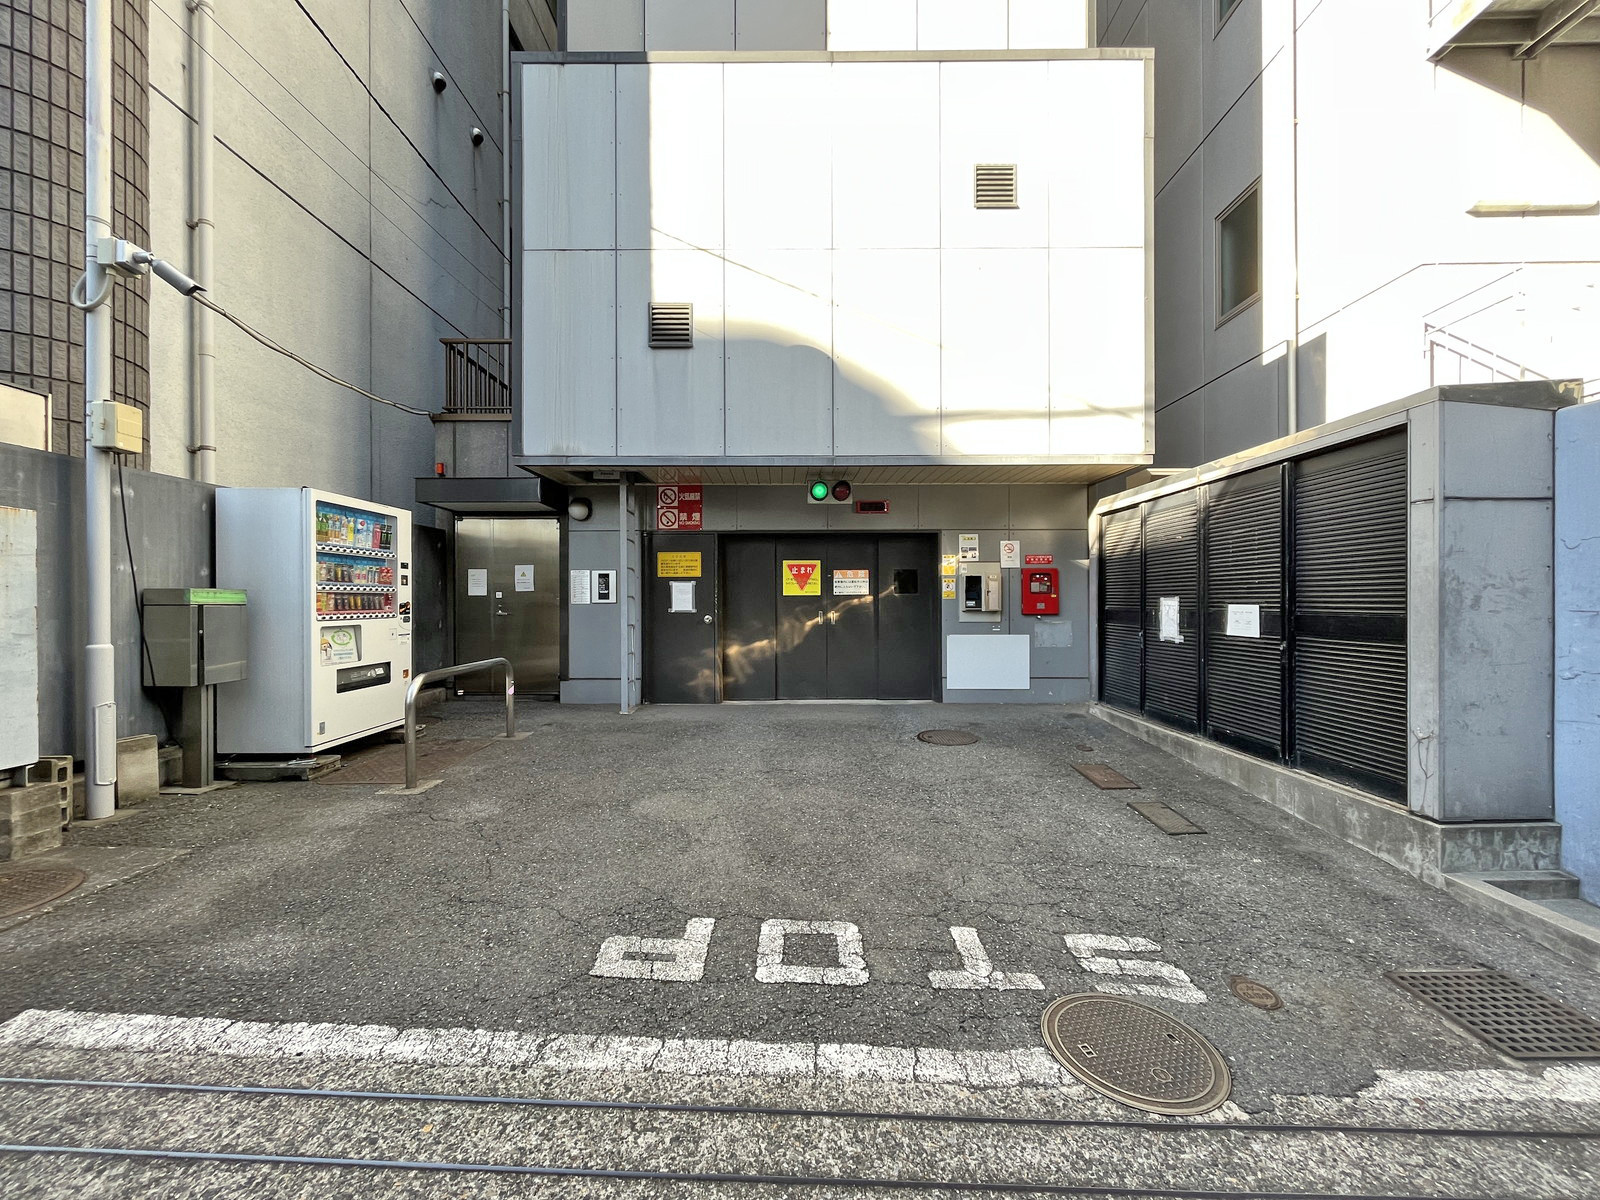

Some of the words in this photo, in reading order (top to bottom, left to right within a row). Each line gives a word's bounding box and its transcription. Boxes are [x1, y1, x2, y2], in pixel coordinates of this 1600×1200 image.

[679, 492, 700, 501] 火気厳禁
[680, 512, 700, 521] 禁煙
[791, 566, 813, 574] 止まれ
[846, 570, 866, 578] 危険
[589, 917, 1207, 1004] STOP
